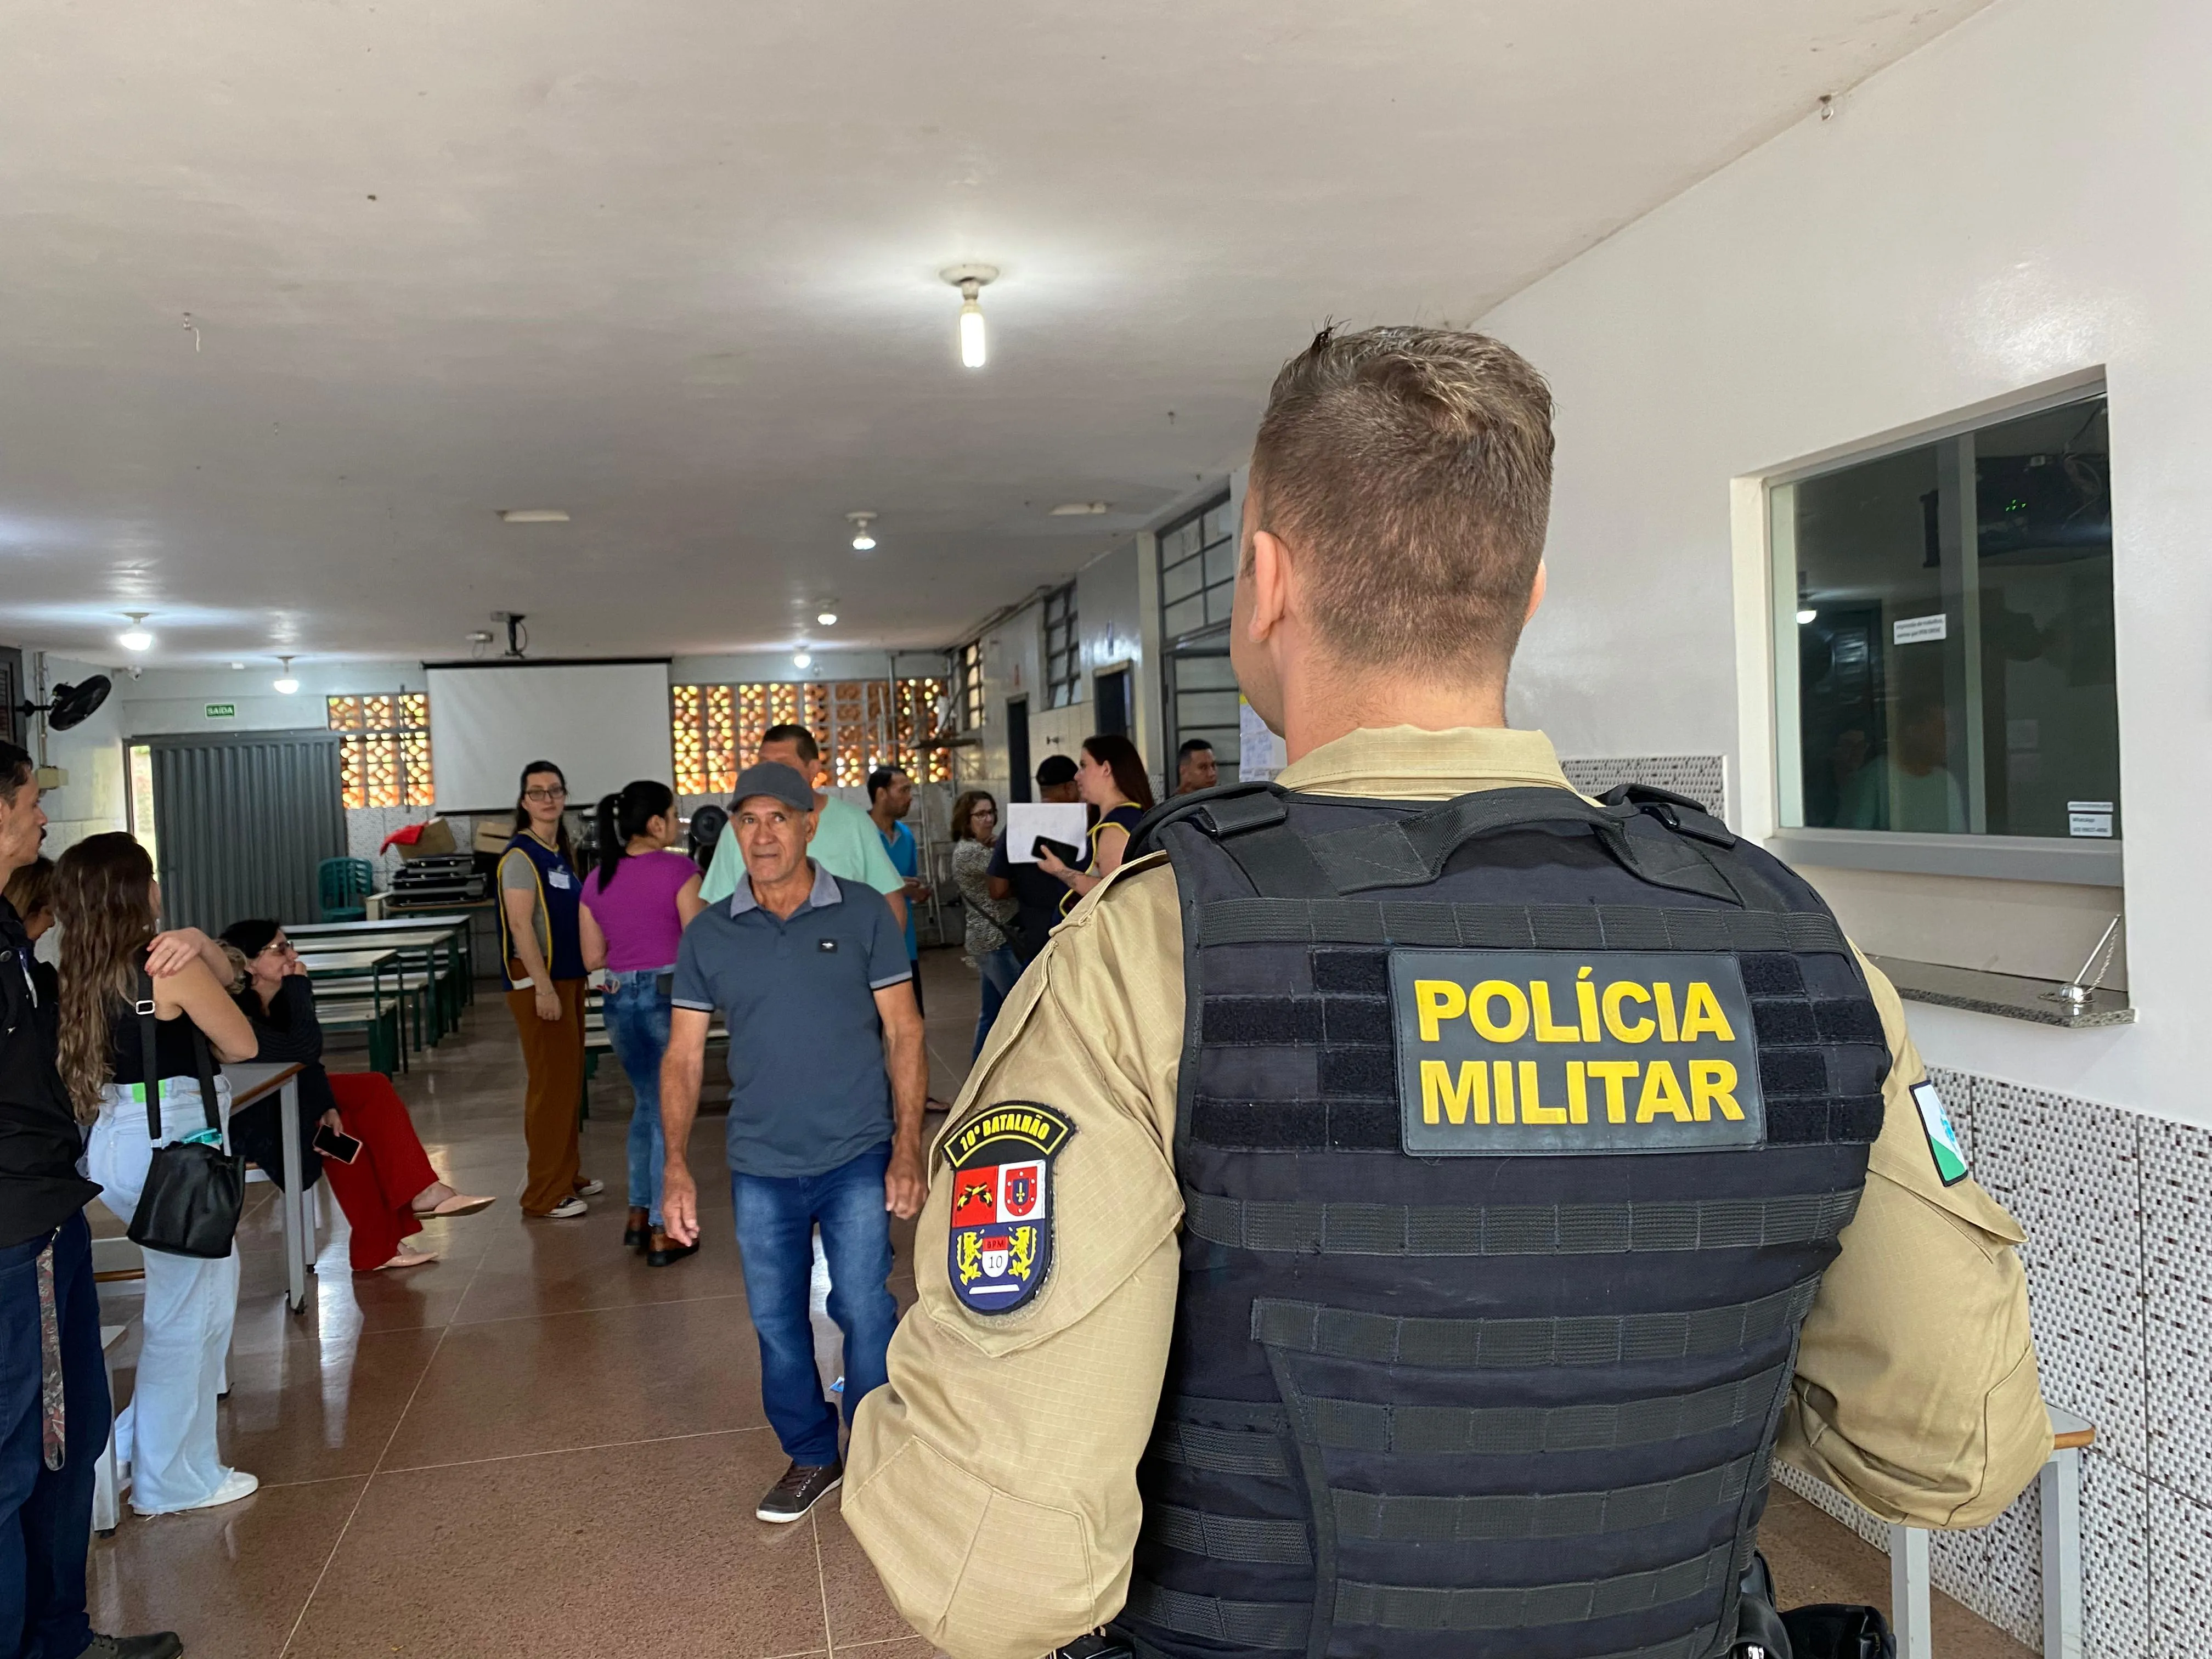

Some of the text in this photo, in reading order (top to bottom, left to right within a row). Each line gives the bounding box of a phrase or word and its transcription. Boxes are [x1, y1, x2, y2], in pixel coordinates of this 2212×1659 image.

[1414, 966, 1735, 1043] POLÍCIA
[1420, 1060, 1745, 1124] MILITAR
[983, 1114, 1050, 1141] BATALHÃO
[989, 1255, 1002, 1268] 10
